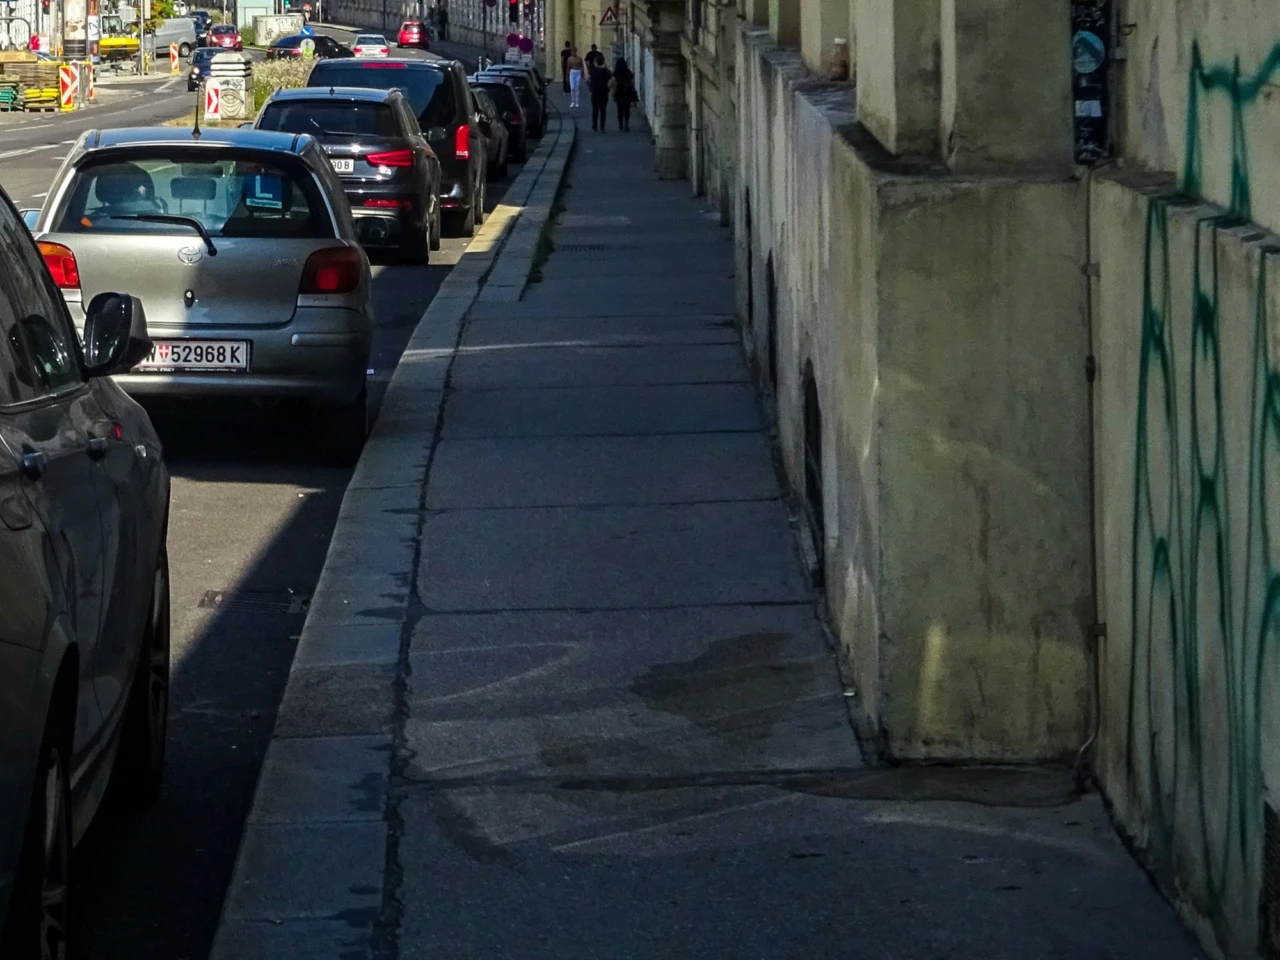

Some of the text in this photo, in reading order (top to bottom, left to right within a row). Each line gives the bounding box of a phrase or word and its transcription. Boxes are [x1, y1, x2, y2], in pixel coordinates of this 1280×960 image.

[344, 161, 350, 170] B
[255, 175, 273, 198] L
[171, 345, 227, 363] 52968
[230, 346, 241, 363] K
